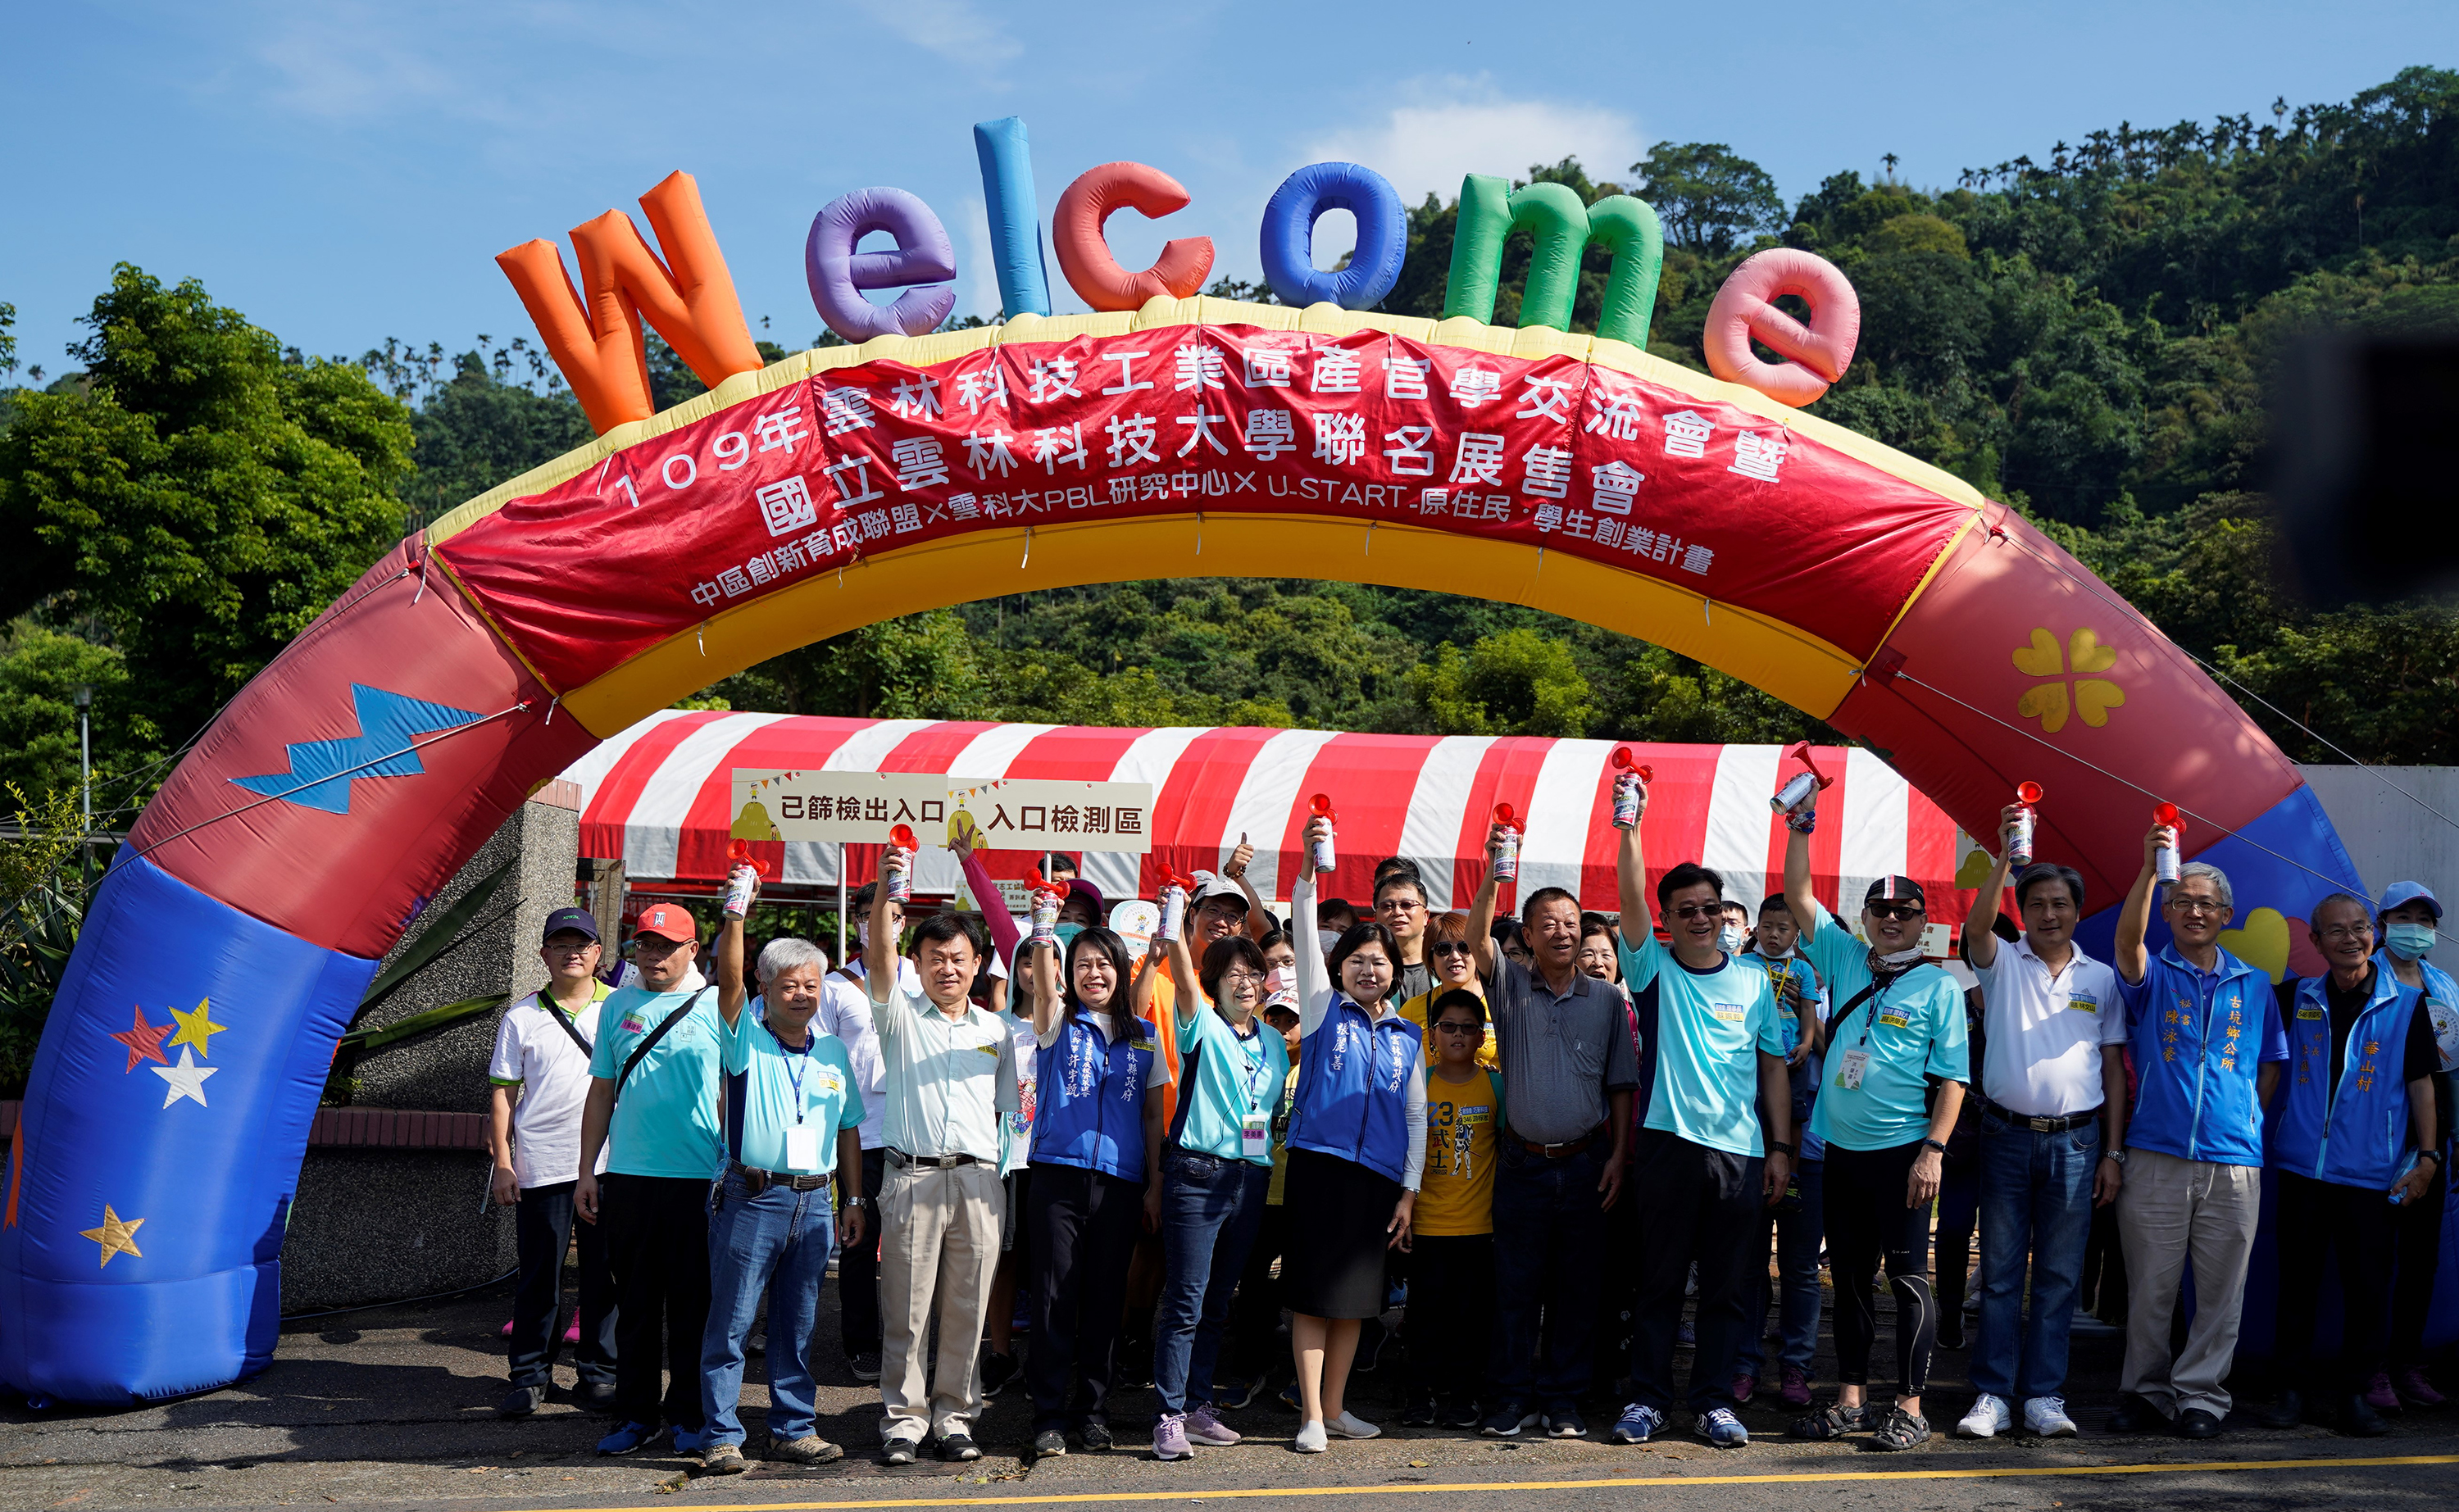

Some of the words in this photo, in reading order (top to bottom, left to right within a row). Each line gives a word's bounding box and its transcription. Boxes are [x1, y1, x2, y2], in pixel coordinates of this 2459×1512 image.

[495, 116, 1860, 436] Welcome
[615, 343, 1786, 508] 109年雲林科技工業區產官學交流會暨
[755, 407, 1646, 538] 國立雲林科技大學聯名展售會
[780, 795, 944, 823] 已篩檢出入口
[987, 803, 1143, 835] 入口檢測區
[2179, 998, 2192, 1026] 秘書
[2220, 995, 2243, 1073] 古坑鄉公所
[1331, 1022, 1350, 1071] 張麗善
[1387, 1034, 1403, 1093] 雲林縣政府
[2355, 1040, 2380, 1092] 華山村
[1427, 1101, 1453, 1126] 23
